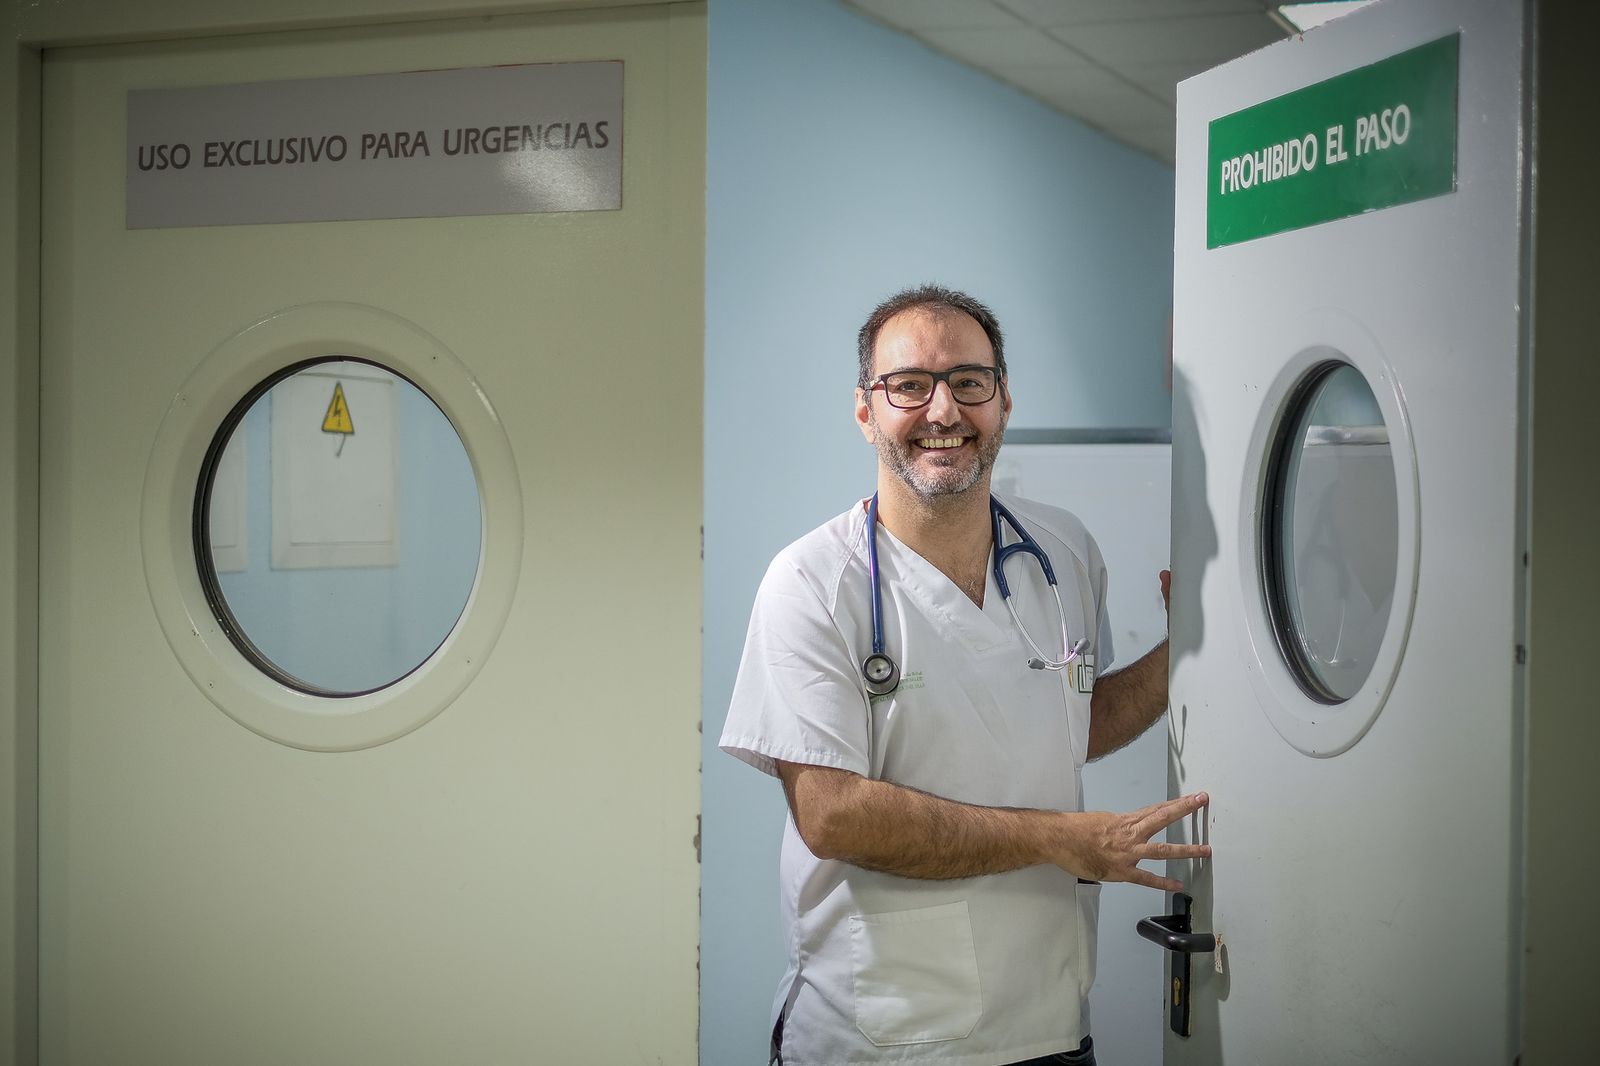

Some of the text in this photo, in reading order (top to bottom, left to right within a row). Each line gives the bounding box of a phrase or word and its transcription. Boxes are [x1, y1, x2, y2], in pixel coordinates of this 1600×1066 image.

[138, 121, 609, 171] USO EXCLUSIVO PARA URGENCIAS
[1221, 104, 1411, 195] PROHIBIDO EL PASO
